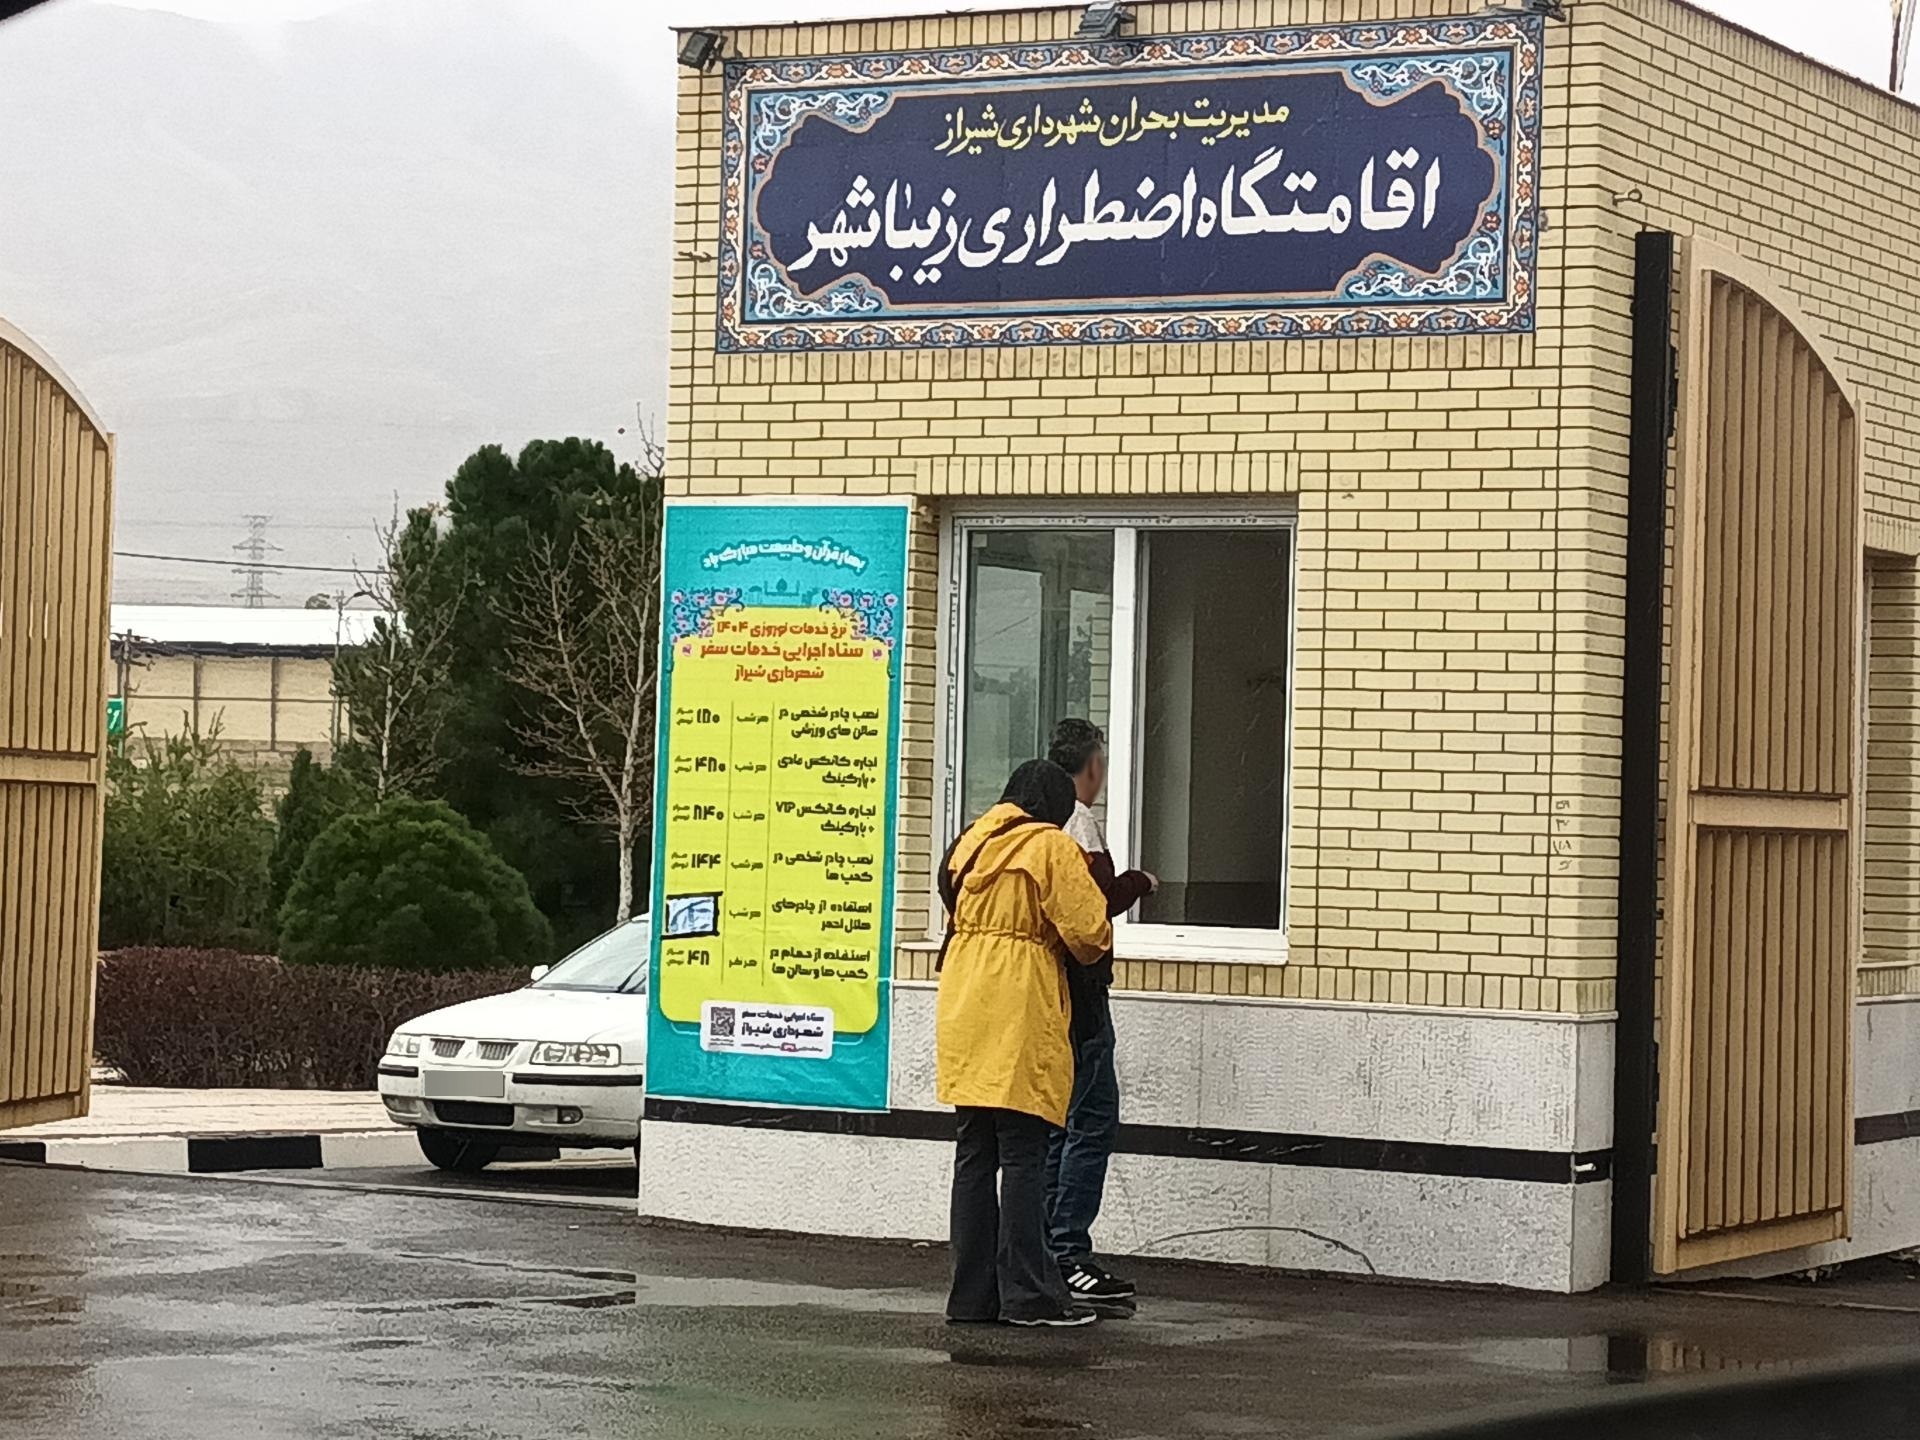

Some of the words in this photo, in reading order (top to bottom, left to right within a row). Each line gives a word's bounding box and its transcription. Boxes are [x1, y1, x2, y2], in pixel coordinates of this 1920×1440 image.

[997, 98, 1100, 149] شهرداری
[1099, 96, 1180, 146] بحران
[1183, 97, 1290, 145] مدیریت
[934, 104, 998, 156] شیراز
[1195, 146, 1441, 238] اقامتگاه
[958, 166, 1197, 268] اضطراری
[759, 538, 804, 557] طبیعت
[717, 621, 748, 633] ۱۴۰۴
[750, 620, 788, 637] نوروزی
[789, 622, 828, 635] خدمات
[830, 621, 847, 639] نرخ
[700, 640, 728, 659] سفر
[731, 641, 781, 656] خدمات
[783, 642, 826, 661] اجرایی
[828, 641, 863, 657] ستاد
[735, 664, 766, 682] شیراز
[767, 665, 824, 683] شهرداری
[697, 708, 720, 723] ۱۵۰
[693, 804, 724, 820] ۸۴۰
[797, 803, 847, 817] کانکس
[691, 853, 721, 869] ۱۴۴
[687, 950, 710, 965] ۴۸
[742, 1023, 771, 1036] شیراز
[773, 1025, 824, 1038] شهرداری
